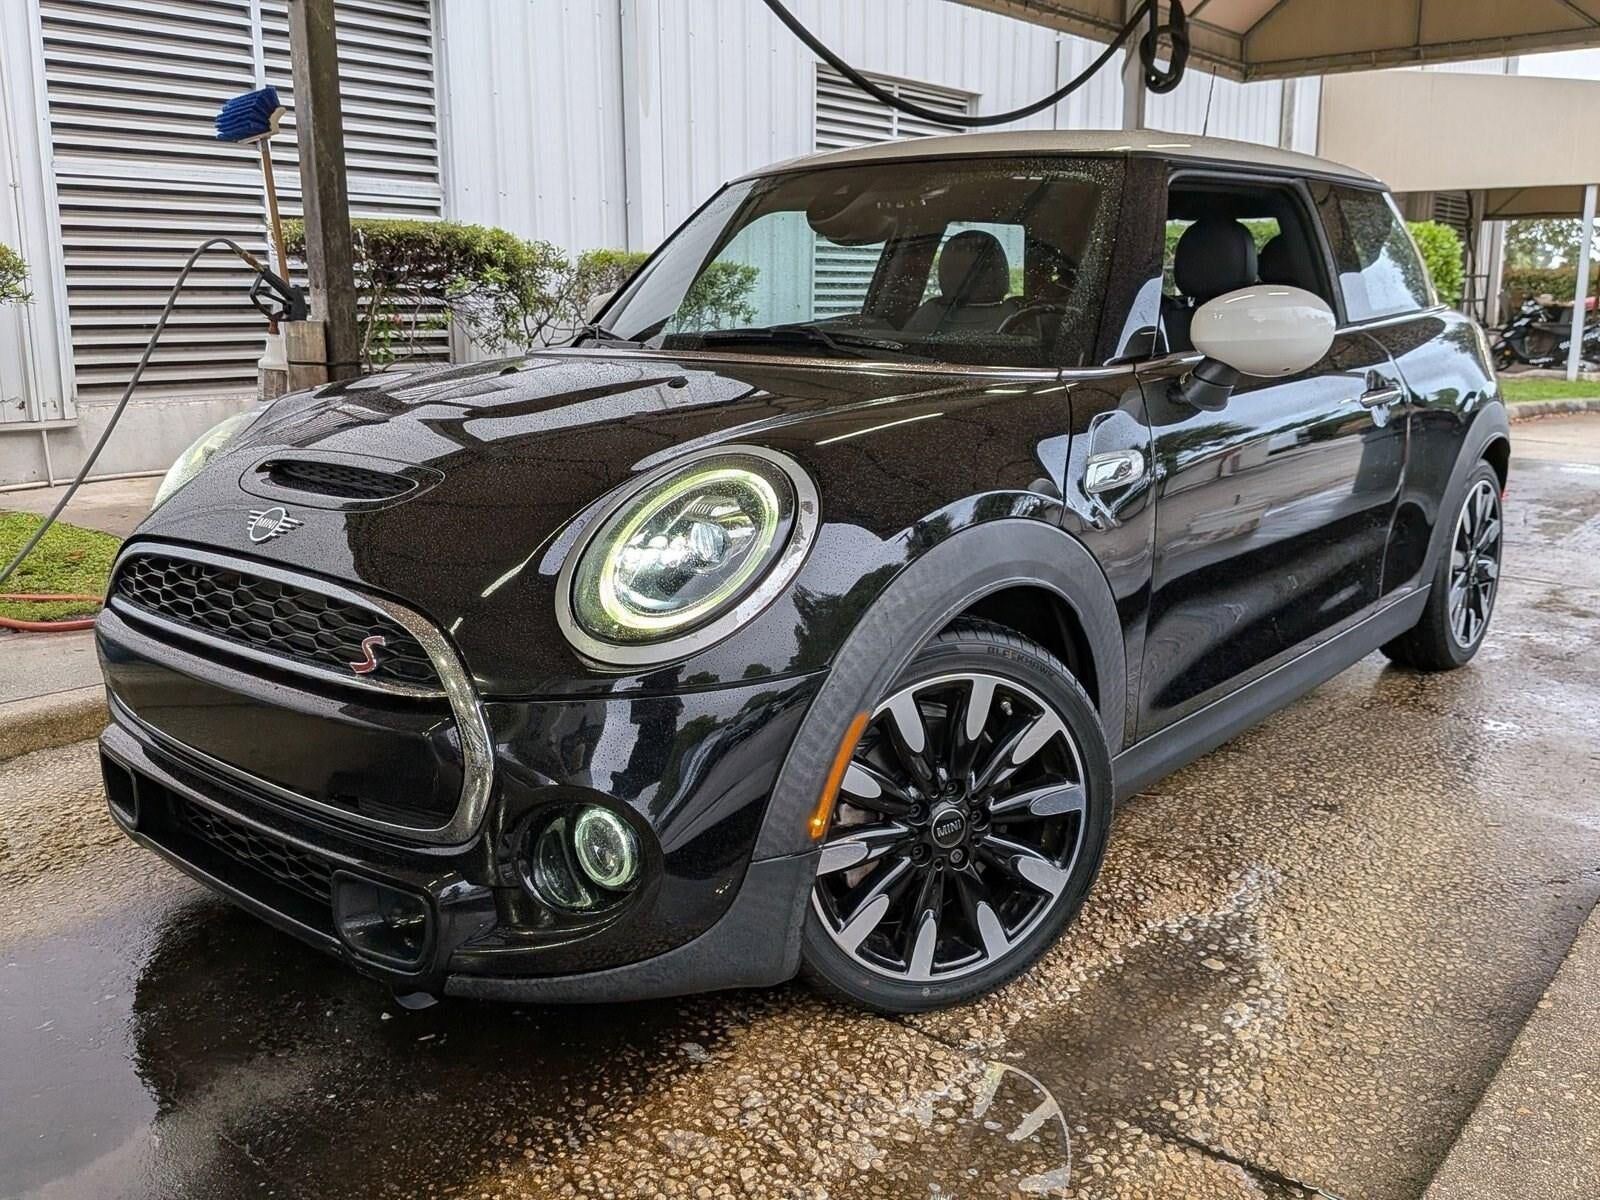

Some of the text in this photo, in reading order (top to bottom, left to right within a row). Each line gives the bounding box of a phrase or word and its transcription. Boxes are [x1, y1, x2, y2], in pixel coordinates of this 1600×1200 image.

[256, 517, 279, 530] MINI
[350, 635, 386, 674] S
[936, 818, 962, 838] MINI
